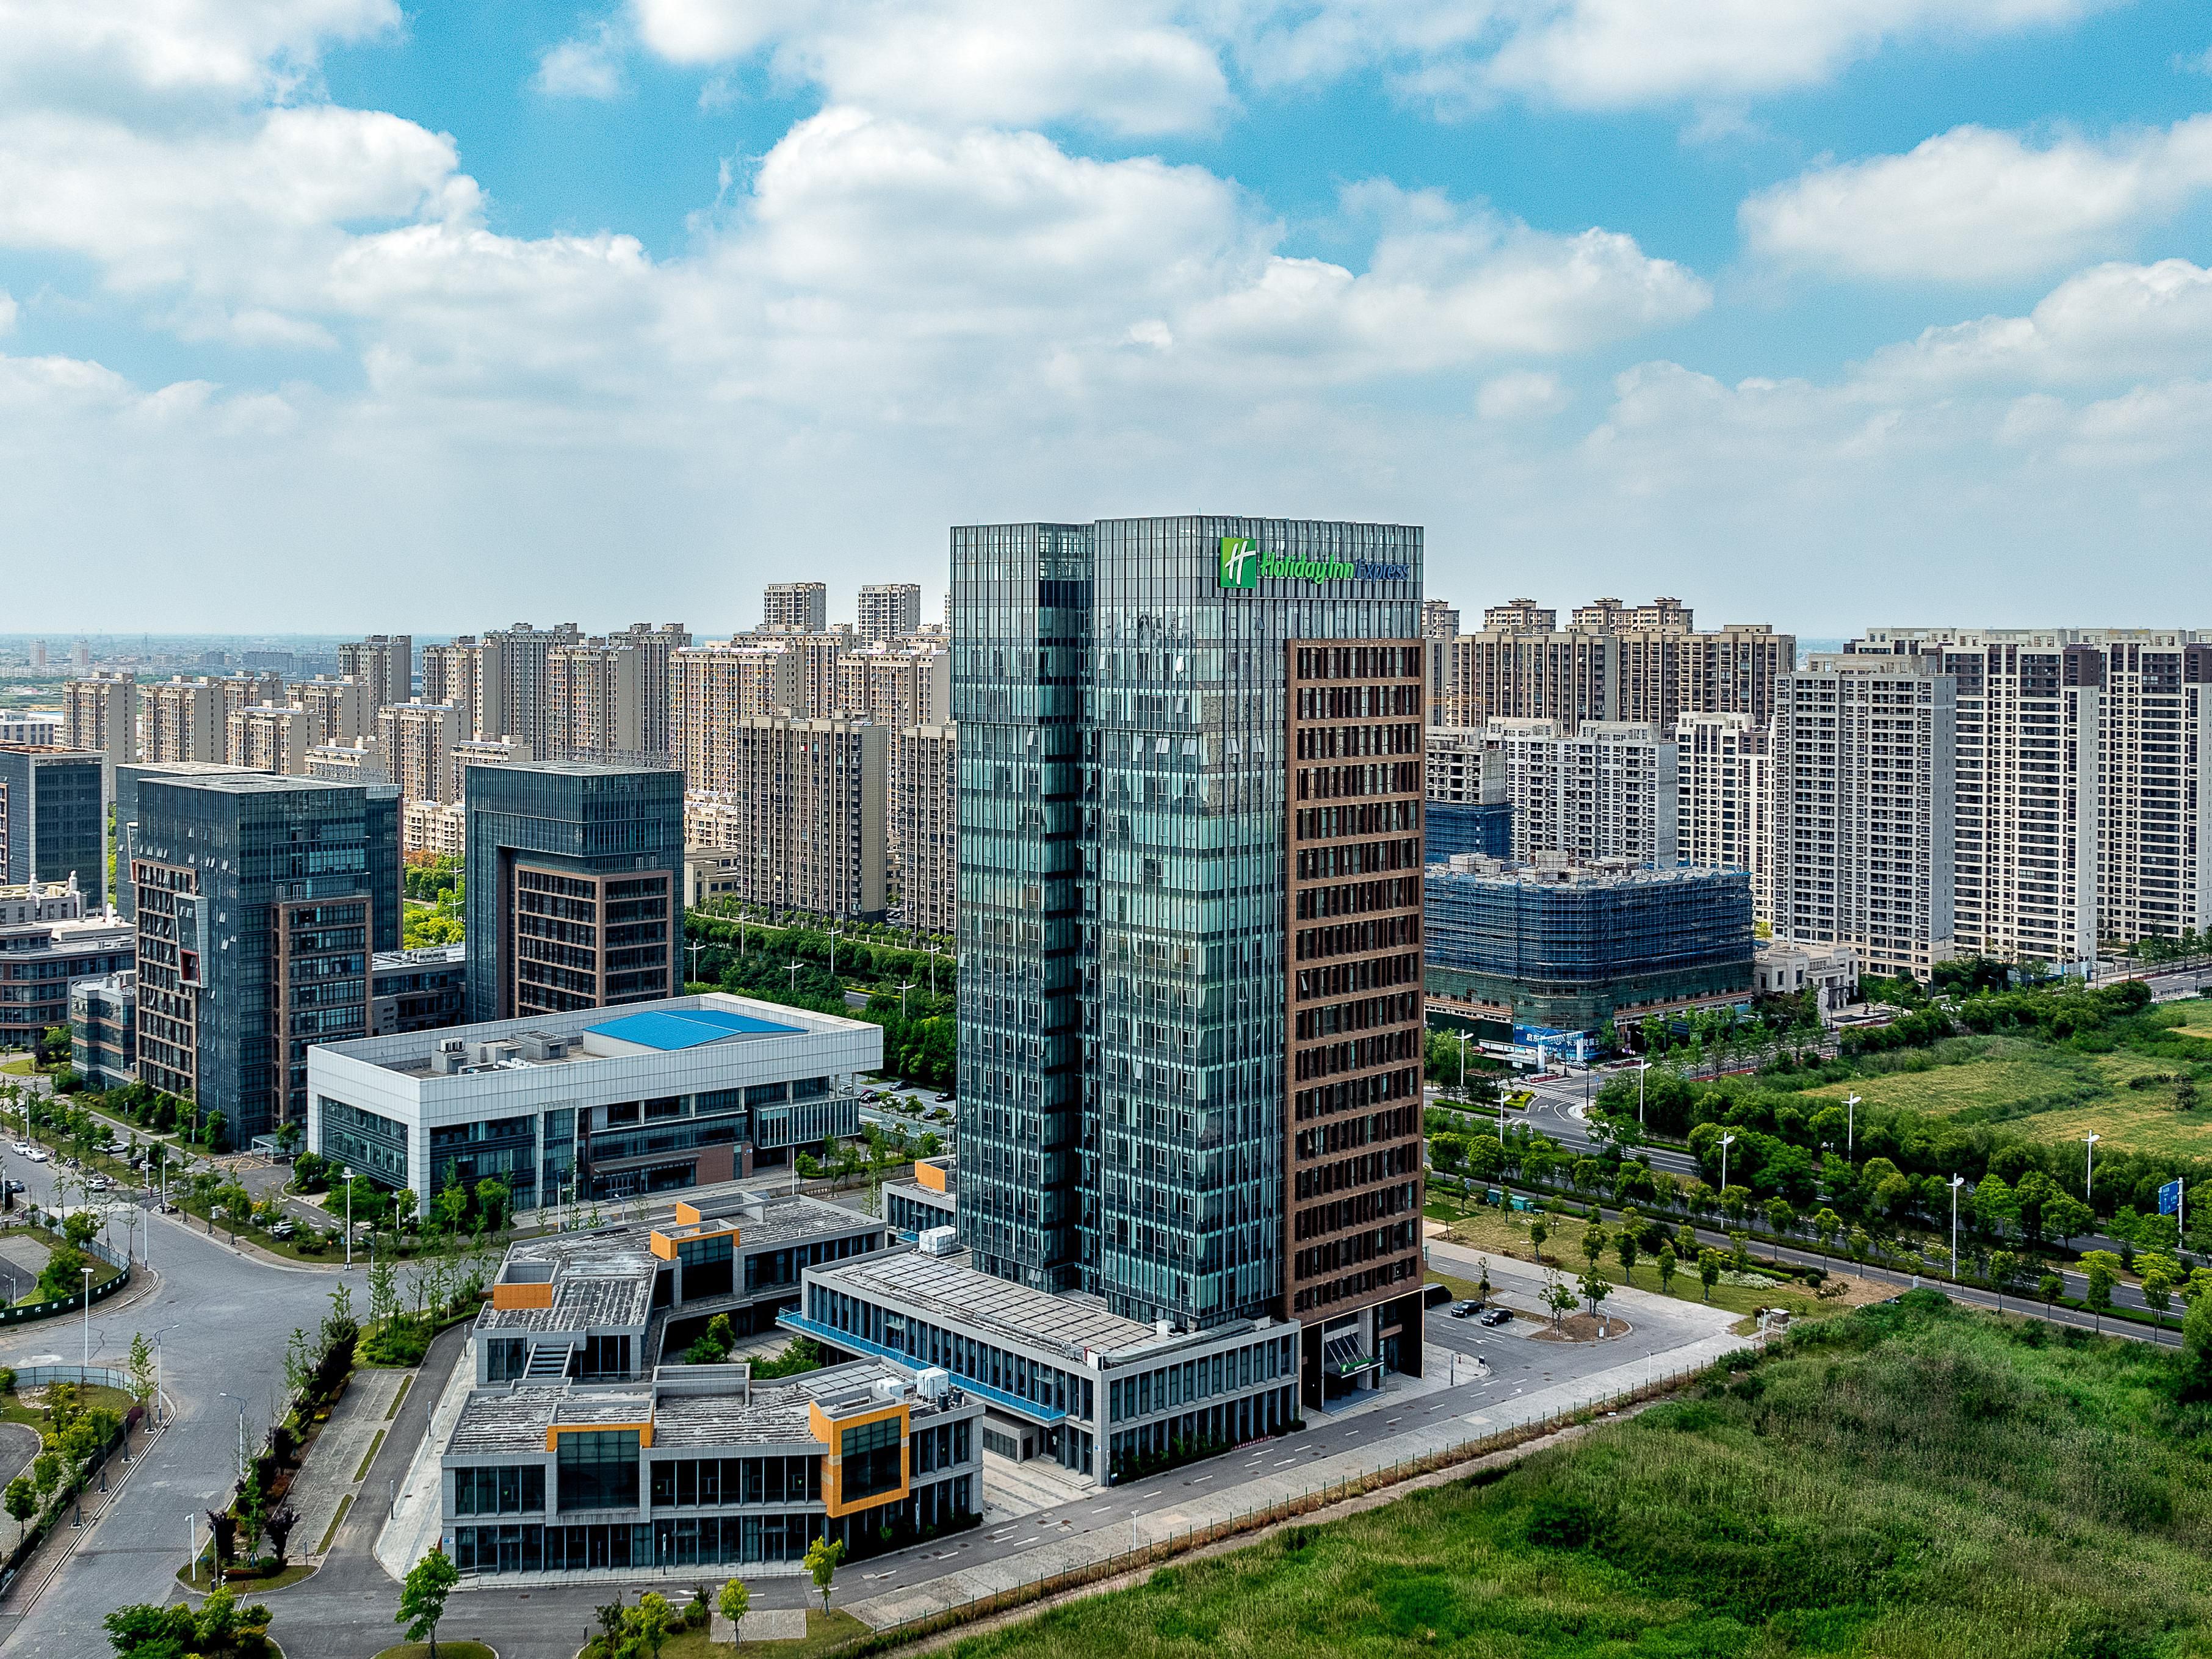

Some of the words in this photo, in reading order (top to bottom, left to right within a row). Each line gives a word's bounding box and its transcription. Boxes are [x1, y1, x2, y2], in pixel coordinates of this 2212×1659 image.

[1260, 551, 1326, 584] Holiday
[1328, 554, 1354, 579] Inn
[1356, 558, 1409, 585] Express
